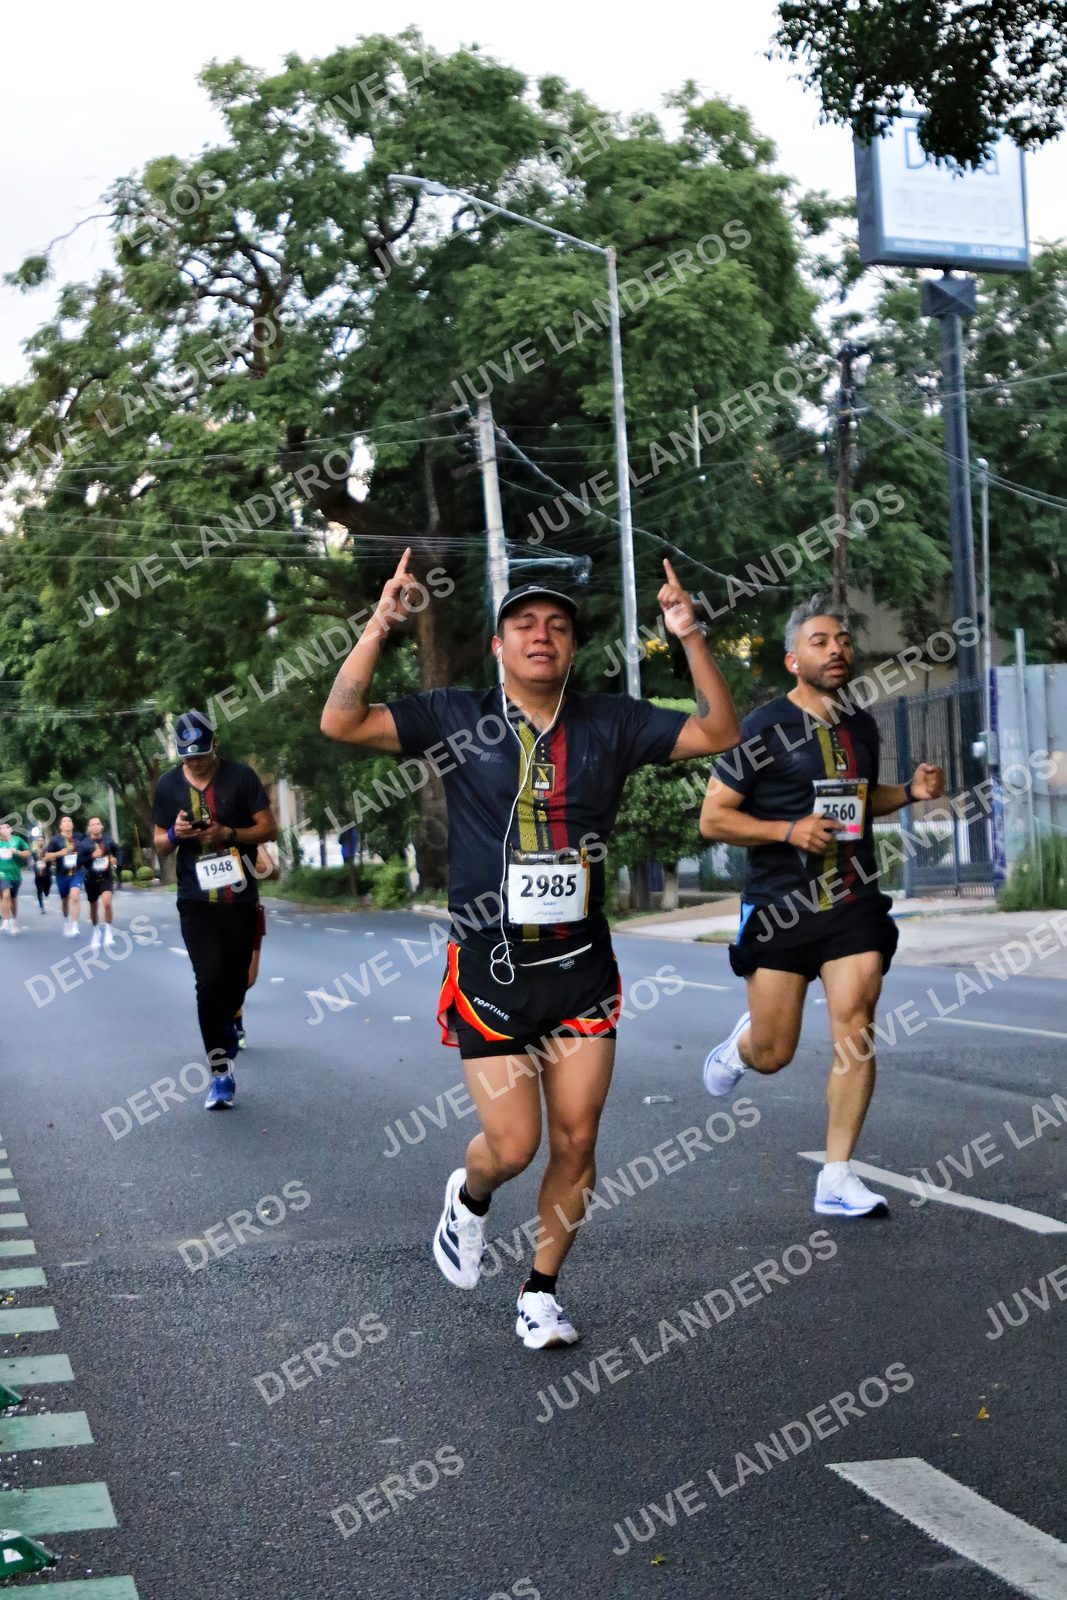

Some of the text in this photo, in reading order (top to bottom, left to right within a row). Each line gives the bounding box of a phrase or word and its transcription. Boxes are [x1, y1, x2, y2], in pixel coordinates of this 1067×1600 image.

[203, 860, 233, 877] 1948
[520, 873, 577, 898] 2985
[473, 997, 511, 1022] TOPTIME
